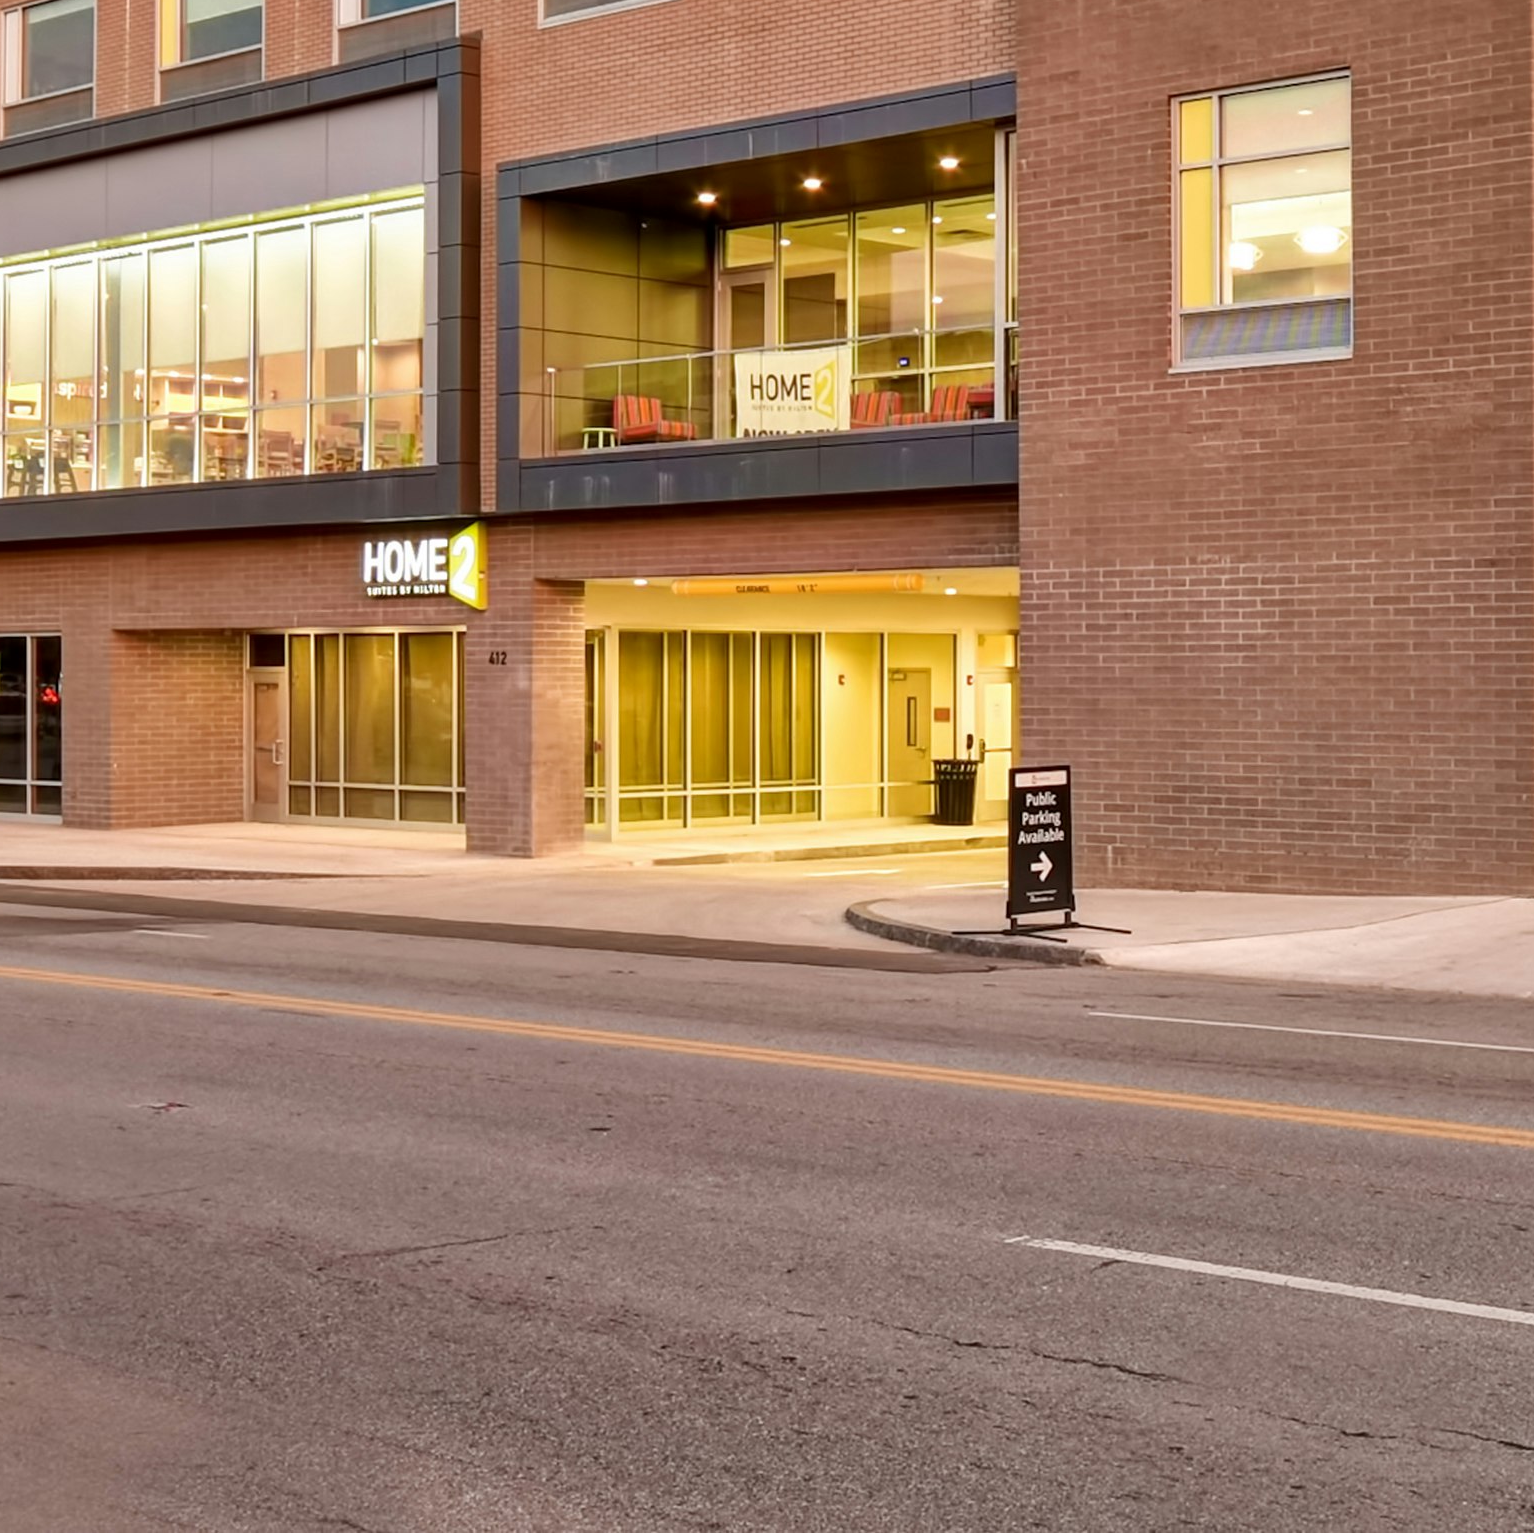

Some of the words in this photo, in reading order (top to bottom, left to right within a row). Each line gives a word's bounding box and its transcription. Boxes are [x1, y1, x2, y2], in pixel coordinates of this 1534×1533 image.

[750, 374, 811, 401] HOME
[816, 367, 834, 415] 2
[363, 538, 448, 583] HOME
[451, 534, 476, 601] 2
[488, 651, 507, 665] 412
[1026, 791, 1057, 807] Public
[1022, 811, 1062, 827] Parking
[1017, 828, 1065, 845] Available
